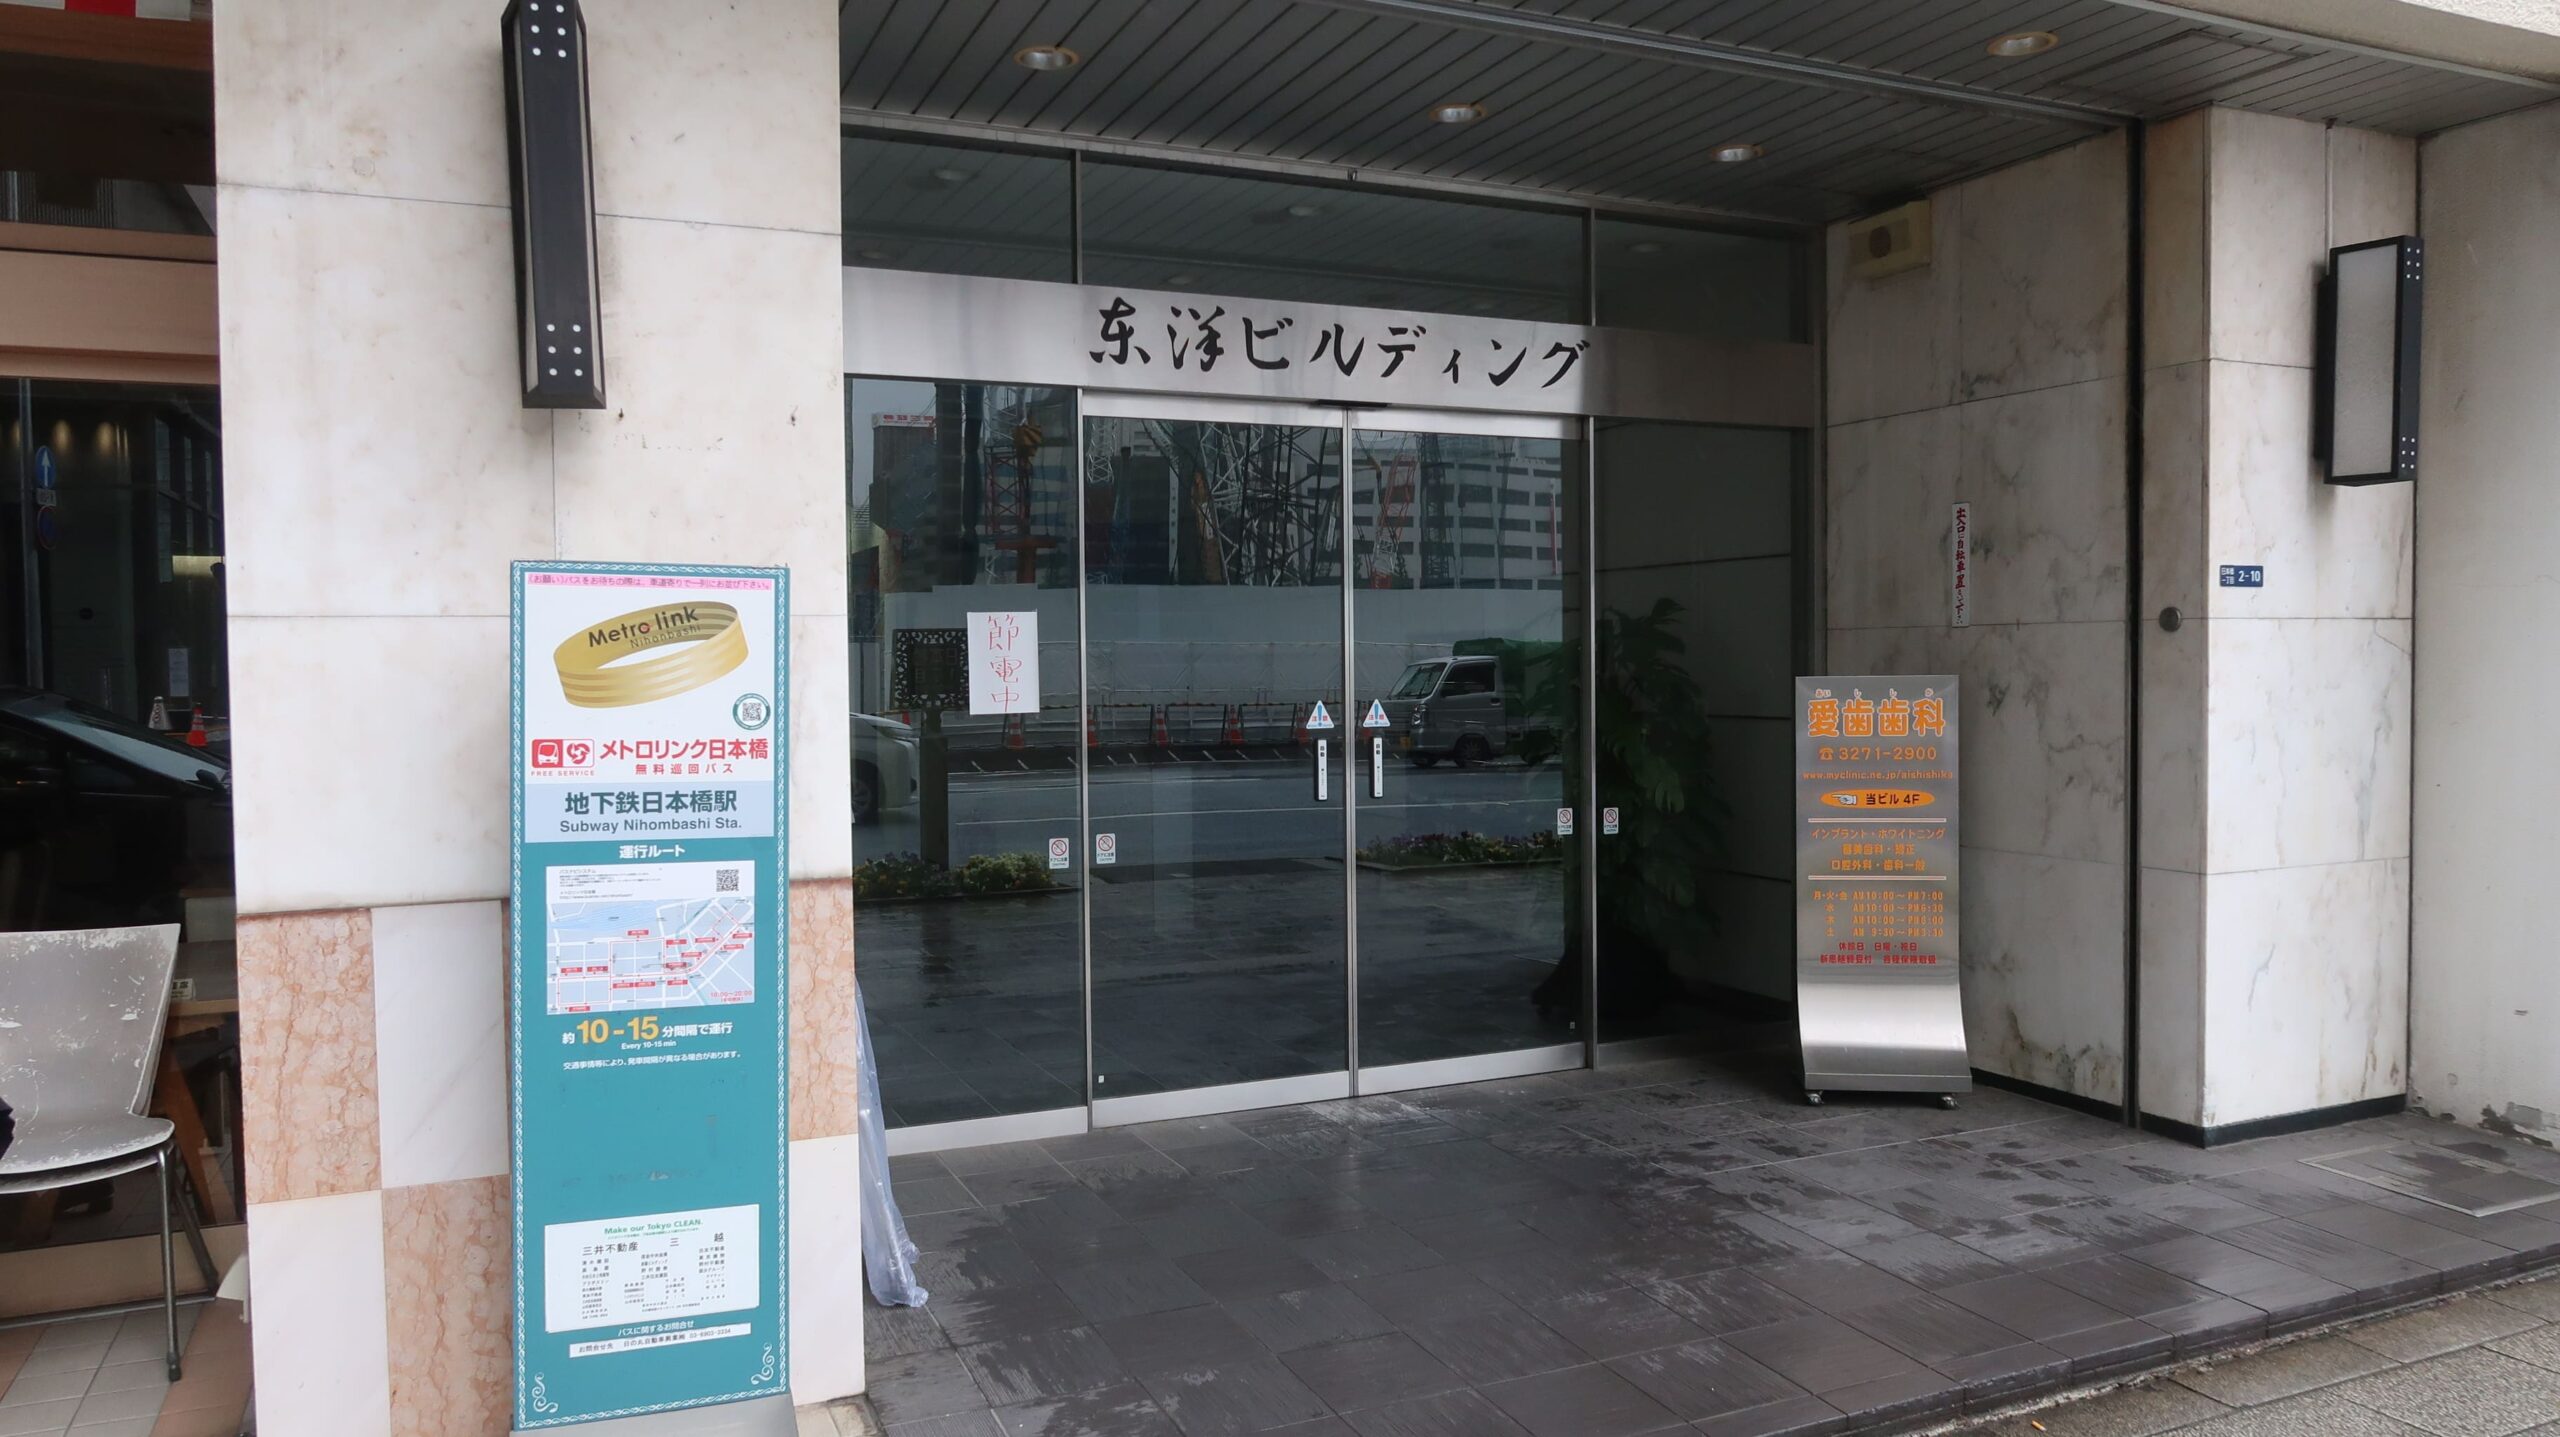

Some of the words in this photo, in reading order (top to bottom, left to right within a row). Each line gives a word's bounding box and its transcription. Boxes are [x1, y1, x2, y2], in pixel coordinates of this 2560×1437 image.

[2238, 571, 2261, 582] 2-10
[588, 621, 650, 647] Metro
[656, 606, 699, 631] link
[987, 614, 1022, 713] 節電中
[1808, 698, 1945, 737] 愛歯歯科
[600, 739, 768, 760] メトロリンク日本橋
[1839, 747, 1937, 760] 3271-2900
[635, 763, 734, 775] 無料巡回バス
[565, 790, 737, 815] 地下鉄日本橋駅
[1866, 793, 1899, 805] 当ビル
[1903, 794, 1920, 804] 4F
[560, 819, 618, 834] Subway
[624, 817, 710, 832] Nihombashi
[715, 817, 742, 829] Sta.
[1811, 828, 1946, 839] インプラント・ホワイトニング
[619, 845, 685, 859] 運行ルート
[1839, 942, 1865, 951] 休診日
[562, 1032, 575, 1045] 約
[662, 1021, 733, 1038] 分間隔で運行
[621, 1042, 641, 1051] Every
[643, 1041, 664, 1049] 10-15
[664, 1040, 677, 1048] min
[604, 1226, 627, 1236] Make
[630, 1225, 645, 1234] our
[647, 1222, 672, 1234] Tokyo
[582, 1241, 639, 1256] 三井不動産
[618, 1320, 694, 1337] バスに関するお問合せ
[579, 1342, 614, 1353] お問合せ先
